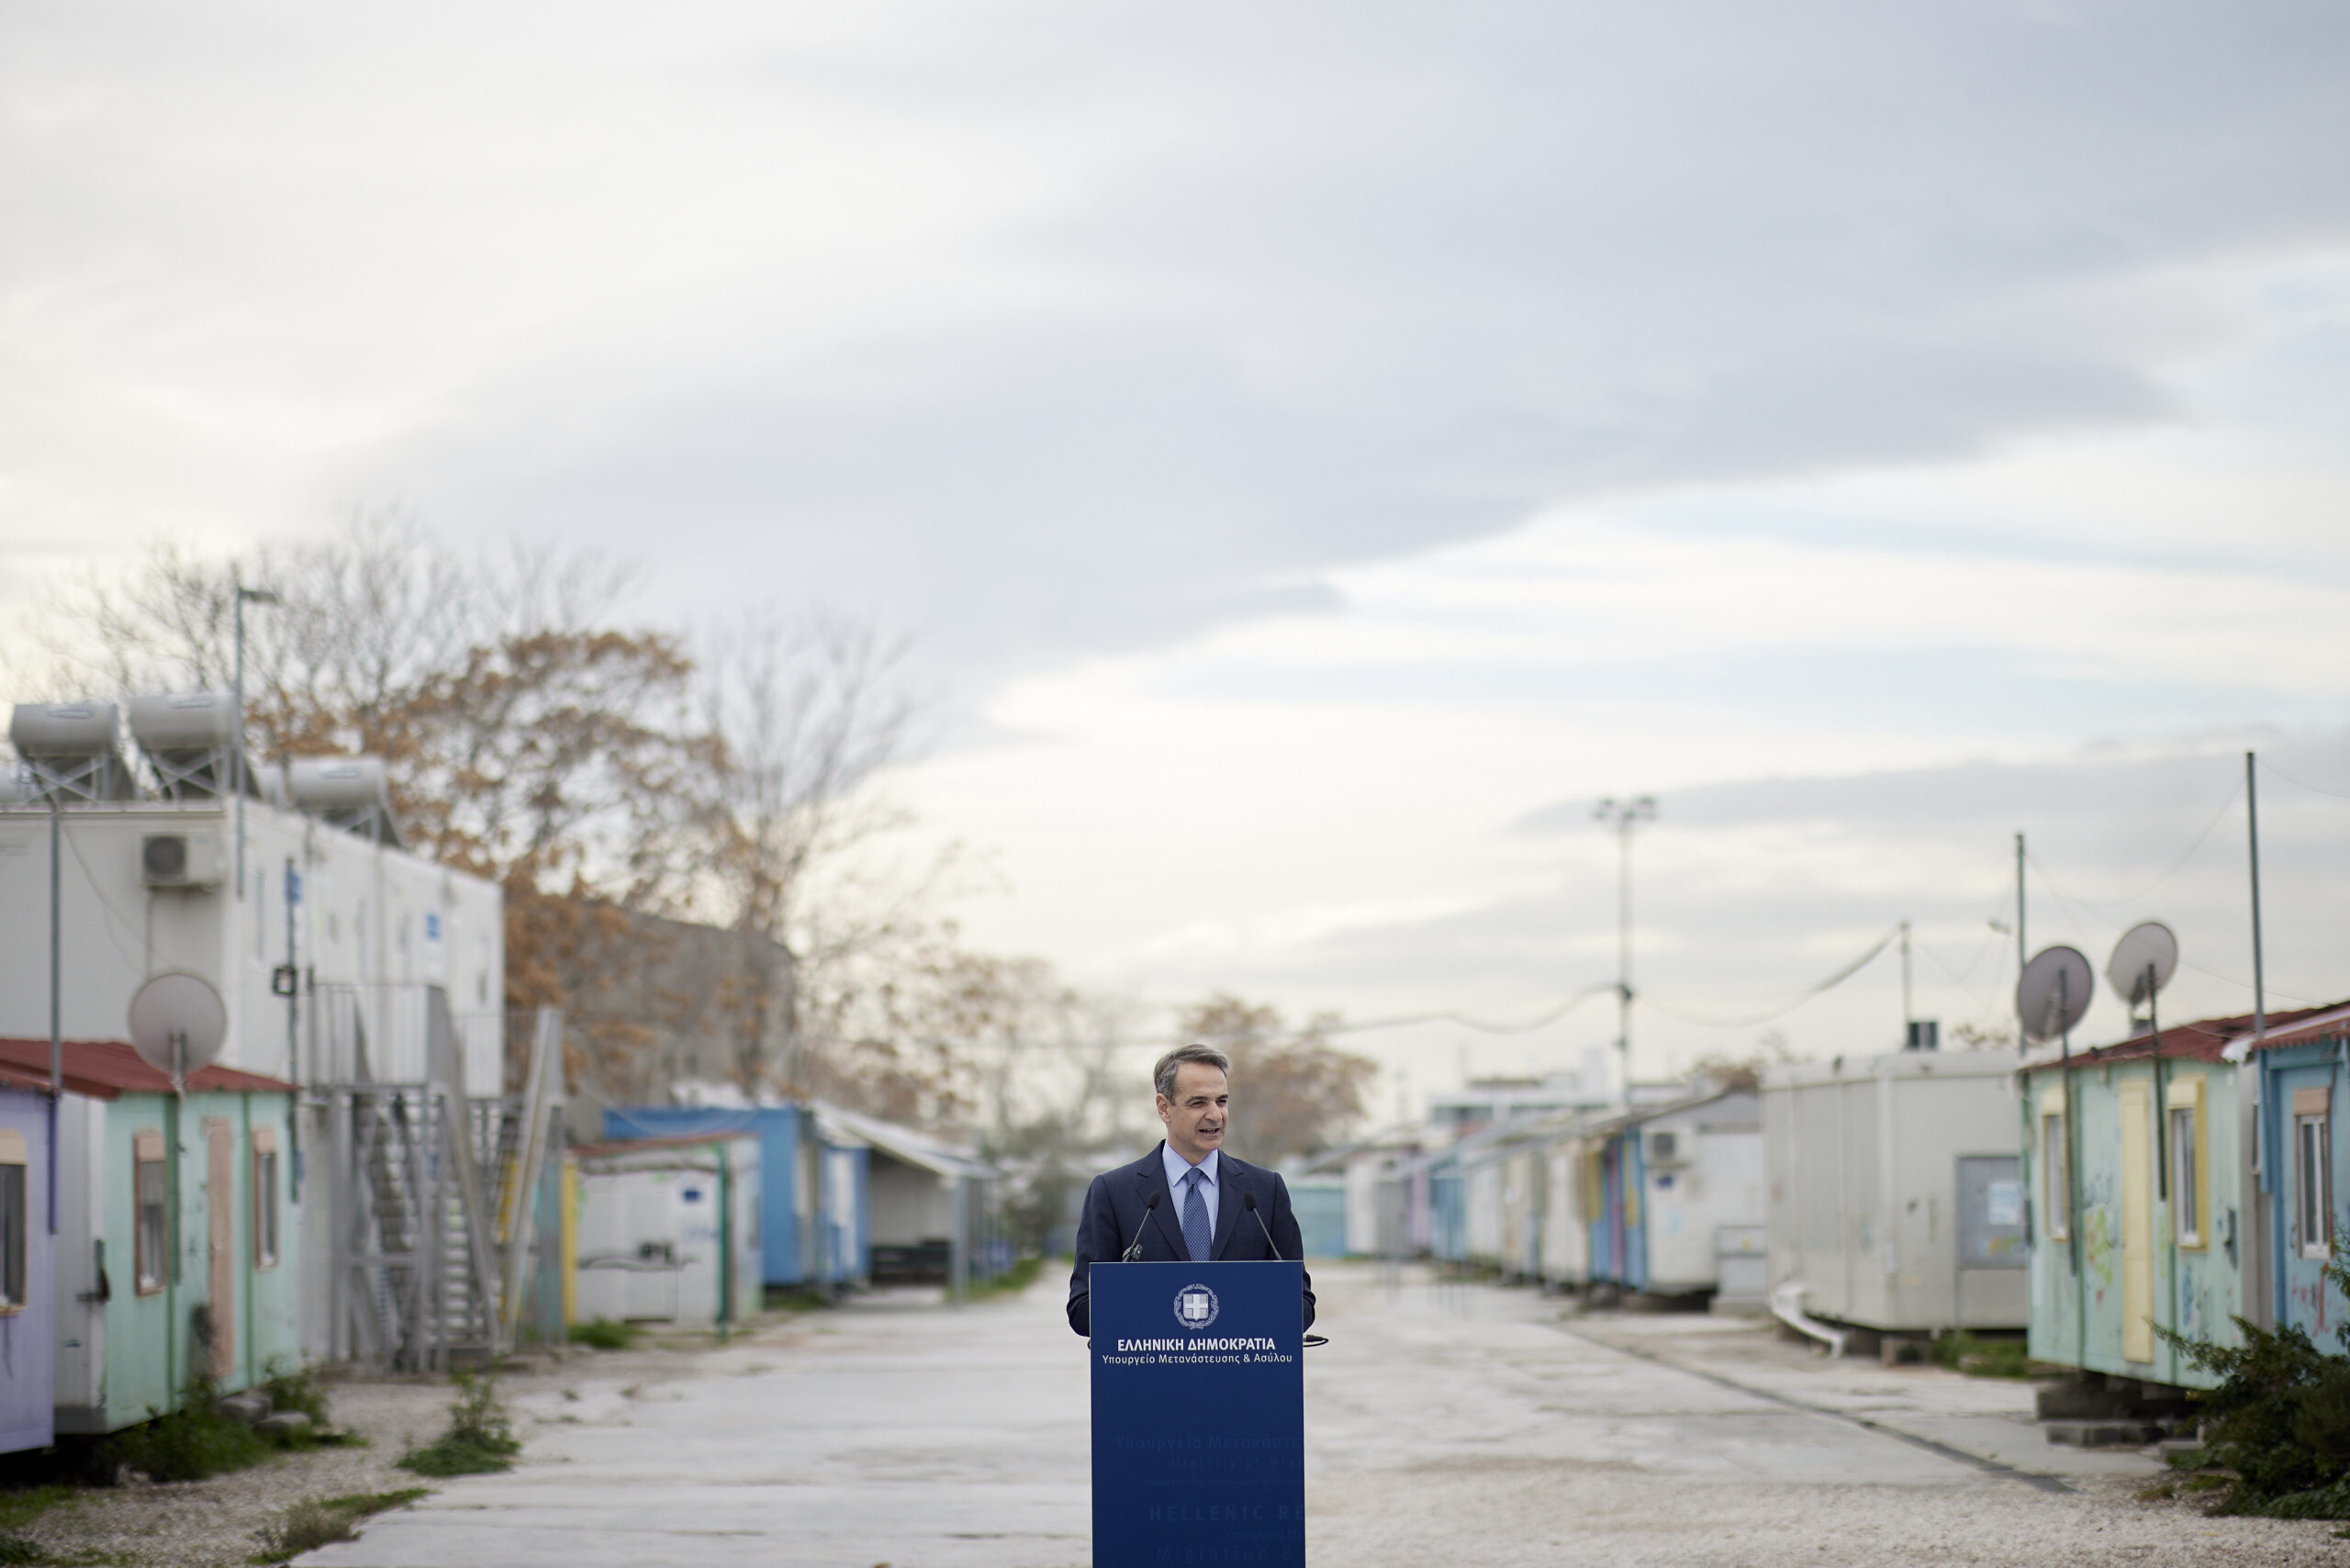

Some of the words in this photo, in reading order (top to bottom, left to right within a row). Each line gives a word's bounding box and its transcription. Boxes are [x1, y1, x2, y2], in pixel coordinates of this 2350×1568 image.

[1117, 1338, 1184, 1351] ΕΛΛΗΝΙΚΗ
[1188, 1338, 1276, 1350] ΔΗΜΟΚΡΑΤΙΑ
[1102, 1354, 1156, 1366] Υπουργείο
[1158, 1353, 1240, 1364] Μετανάστευσης
[1243, 1353, 1250, 1362] &
[1253, 1352, 1292, 1362] Ασύλου
[1149, 1506, 1264, 1521] HELLENIC
